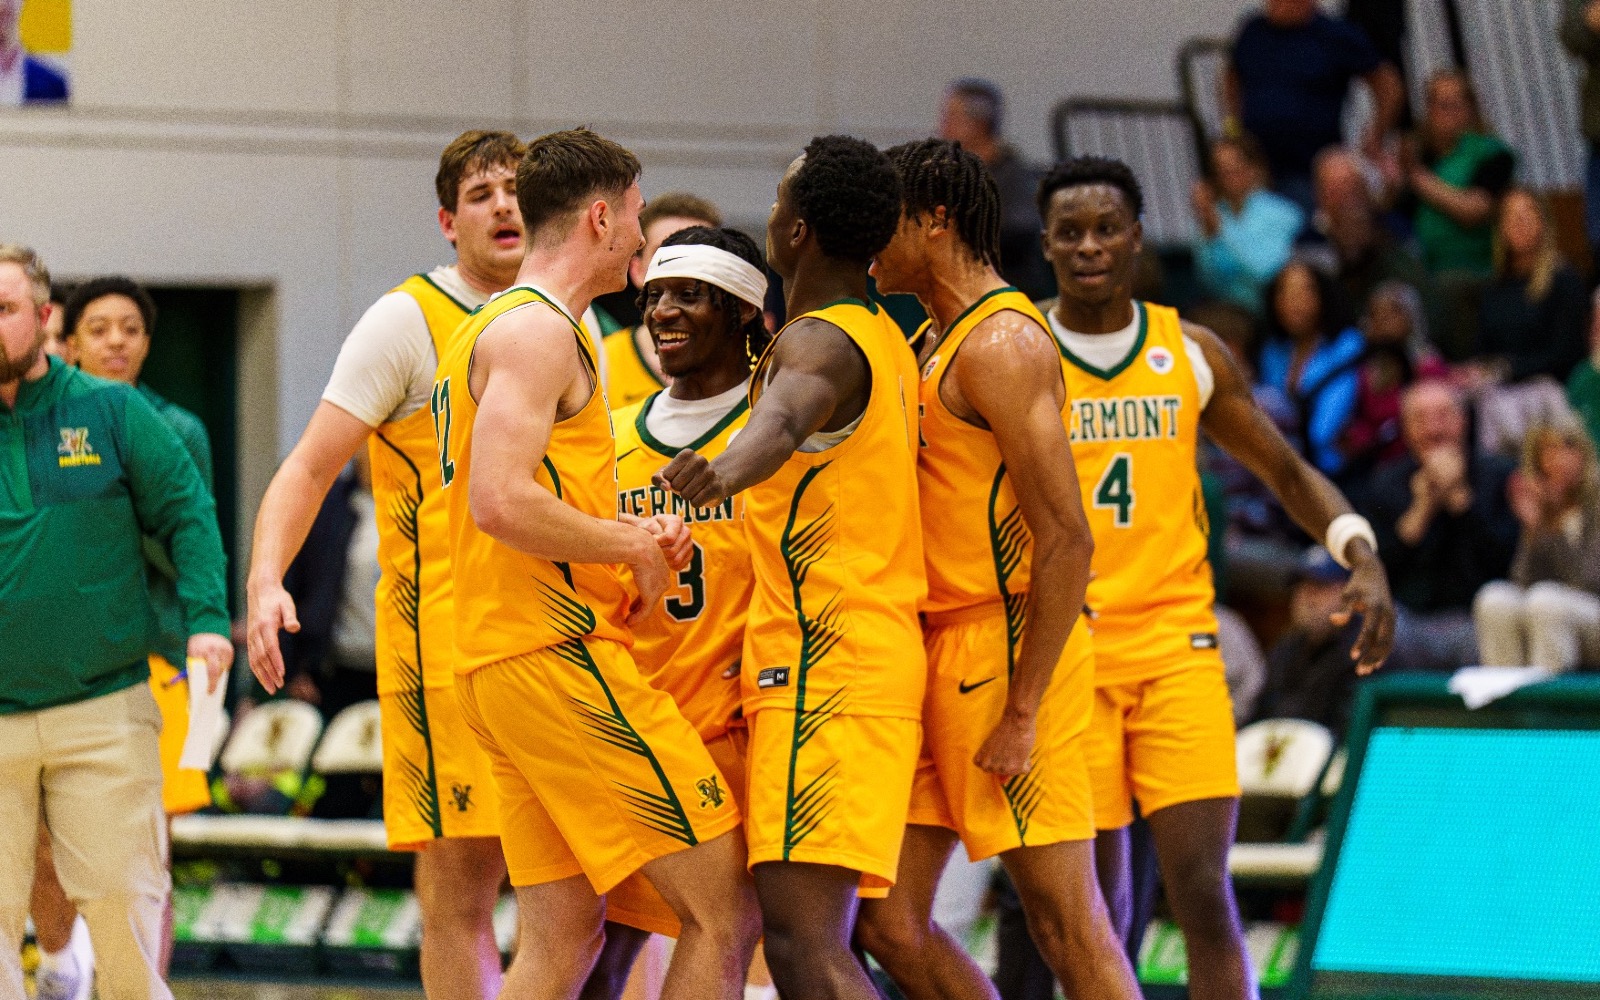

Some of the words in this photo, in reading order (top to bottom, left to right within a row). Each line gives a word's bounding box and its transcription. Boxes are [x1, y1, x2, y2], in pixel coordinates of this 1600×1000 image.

[431, 376, 455, 490] 12
[1093, 452, 1137, 529] 4
[664, 538, 707, 622] 3
